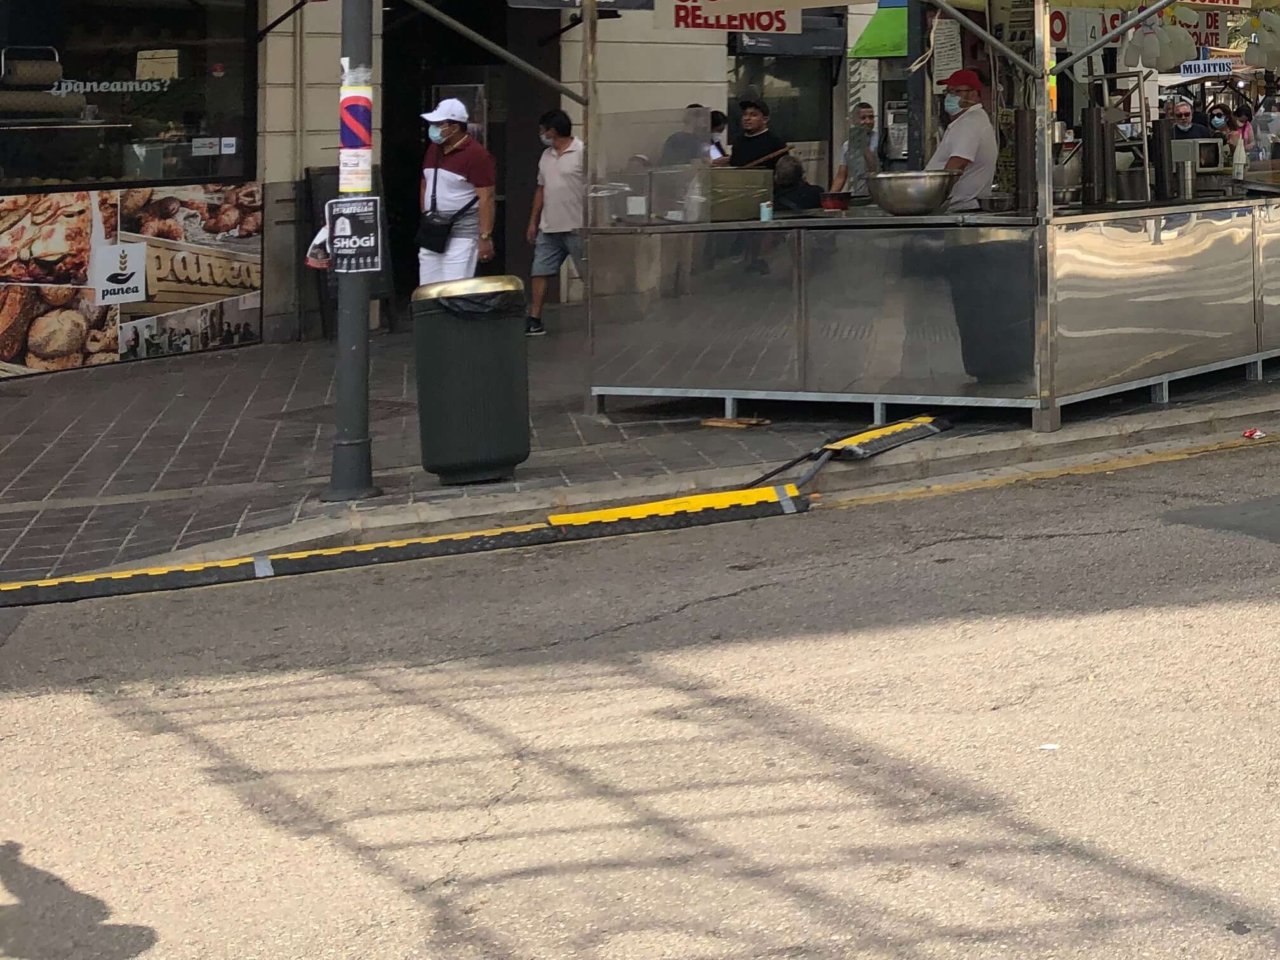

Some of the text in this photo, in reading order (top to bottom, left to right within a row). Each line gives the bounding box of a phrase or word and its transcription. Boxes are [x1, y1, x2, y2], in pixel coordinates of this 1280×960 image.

[1206, 12, 1219, 30] DE
[1182, 61, 1232, 75] MOJITOS
[51, 79, 171, 98] ¿paneamos?
[147, 246, 261, 297] panea
[101, 285, 139, 301] panea
